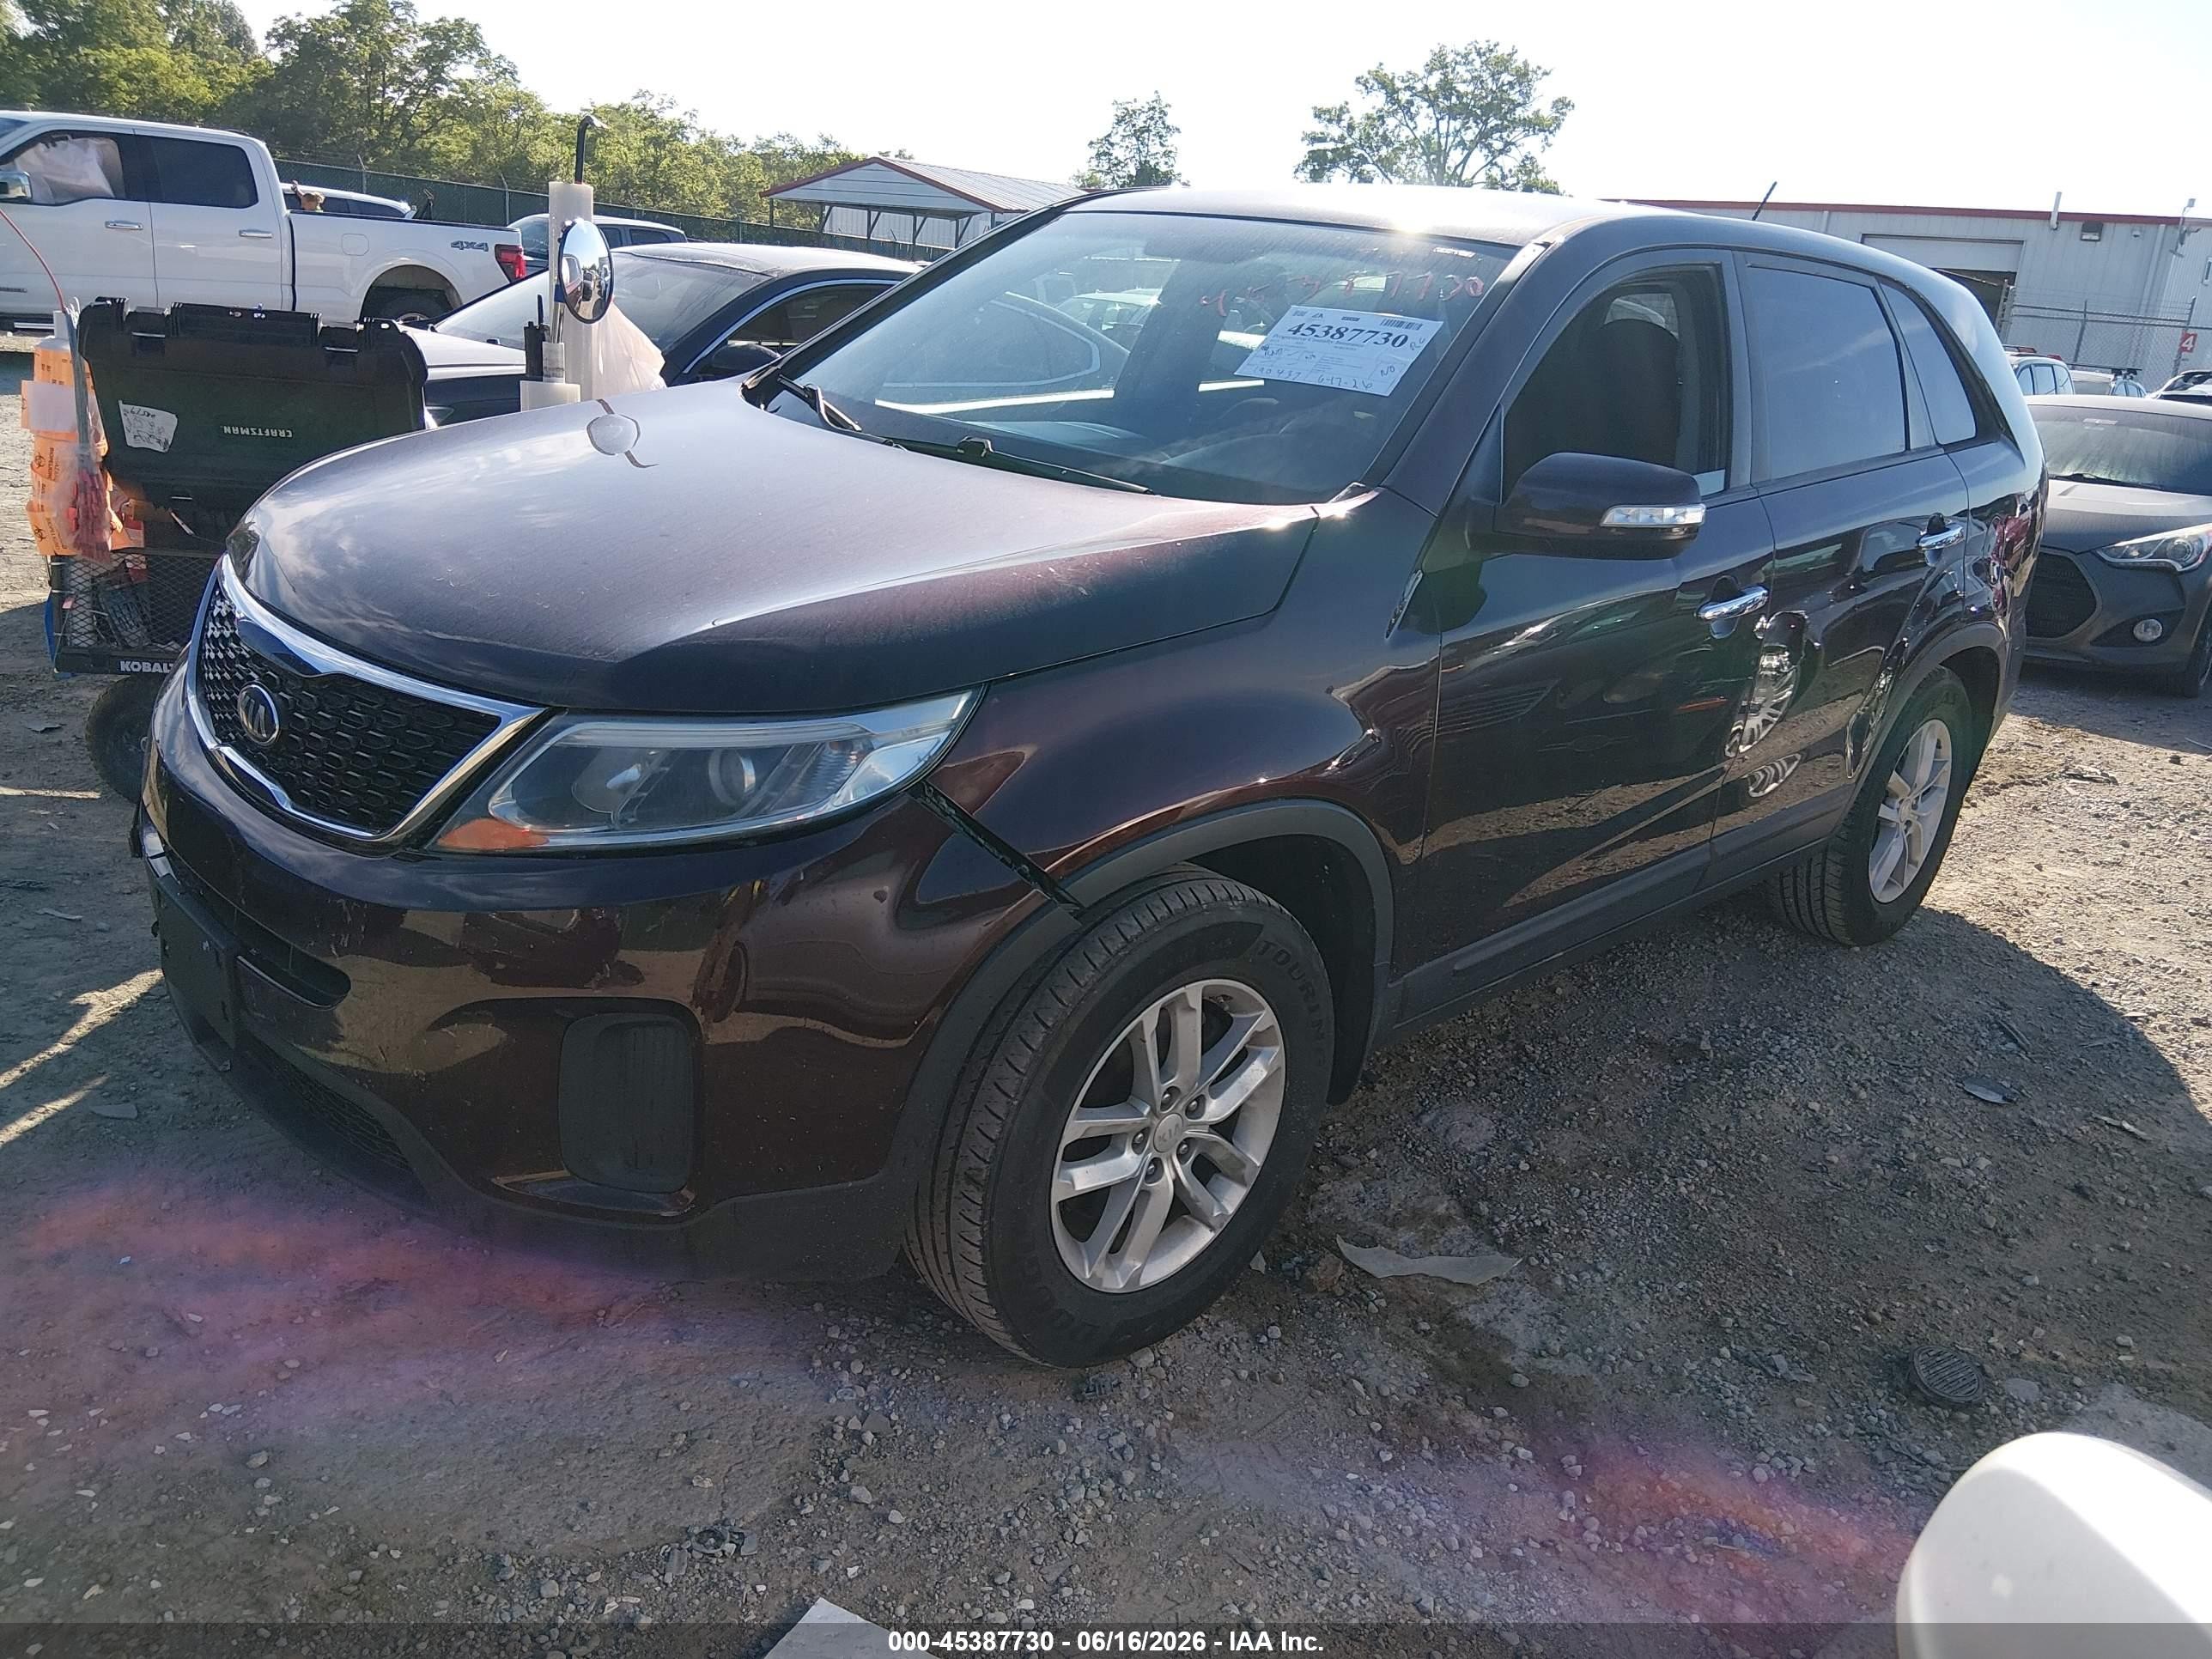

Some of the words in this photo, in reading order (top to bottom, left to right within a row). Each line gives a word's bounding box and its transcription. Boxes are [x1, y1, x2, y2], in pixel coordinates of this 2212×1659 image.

[1287, 323, 1409, 348] 45387730
[2181, 335, 2195, 350] 4
[223, 425, 293, 438] CRAFTSMAN
